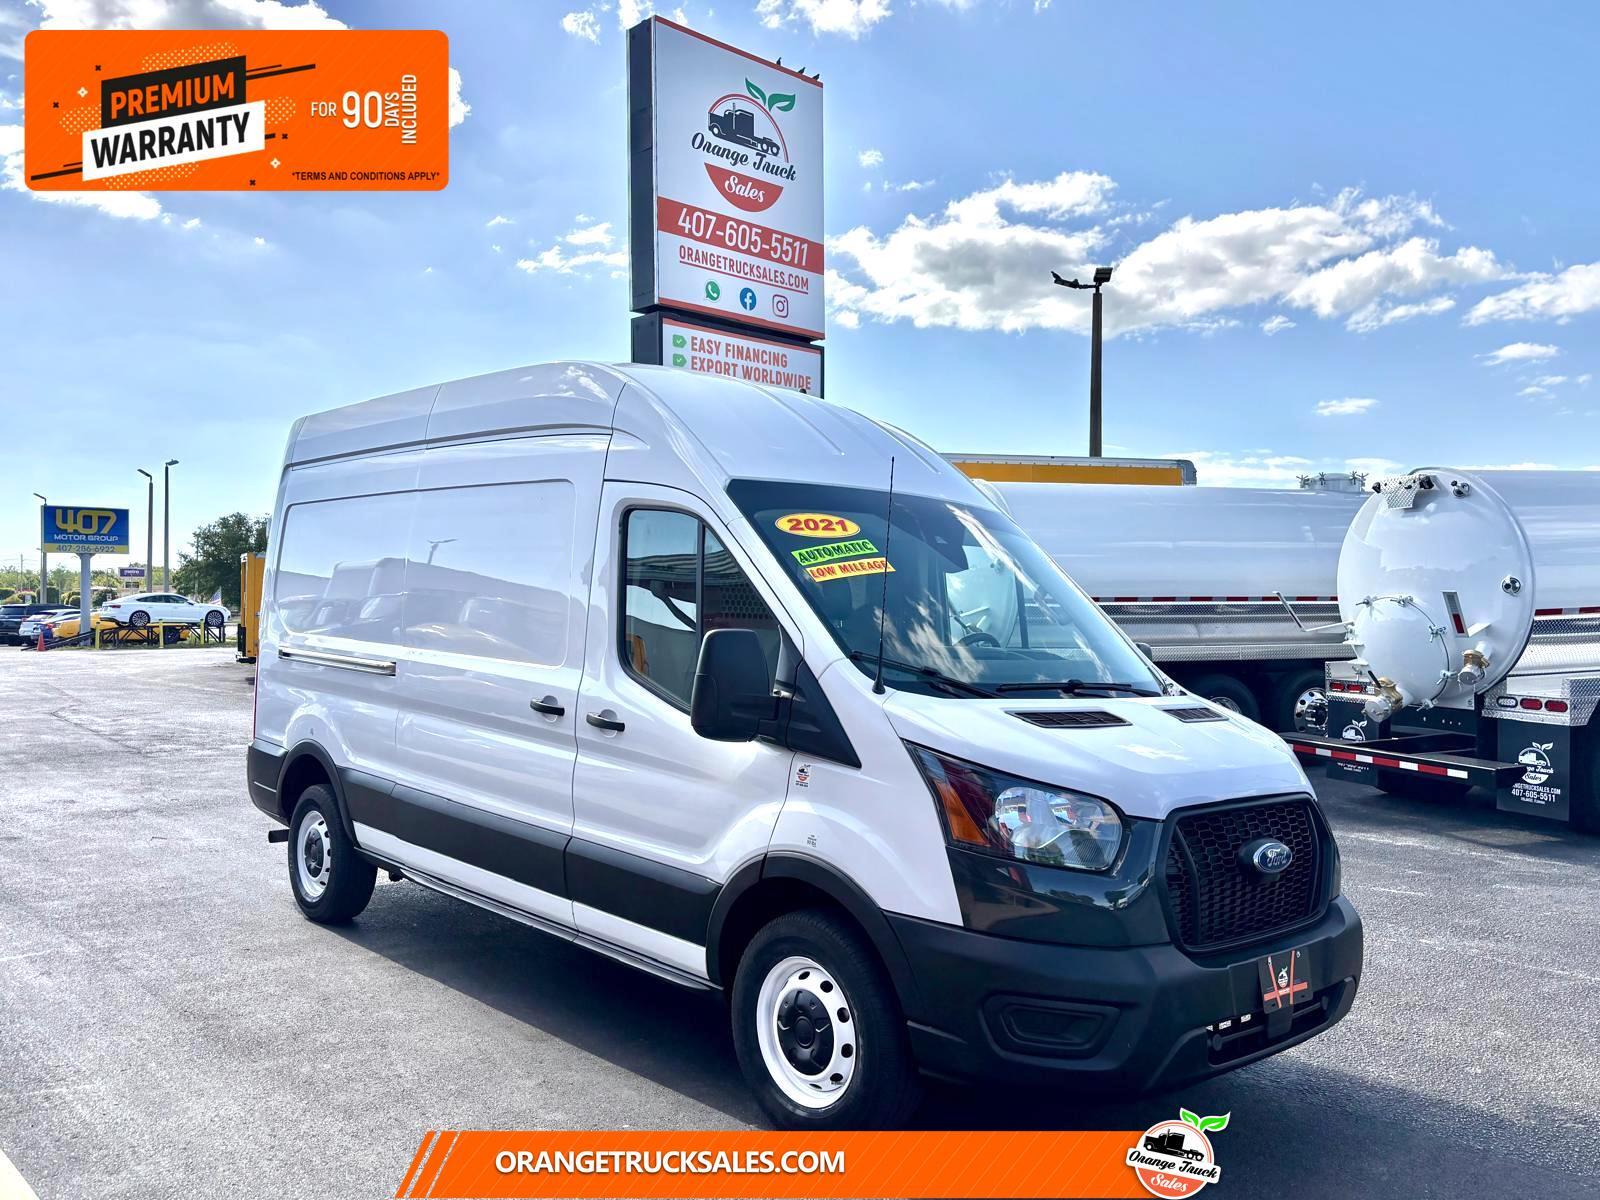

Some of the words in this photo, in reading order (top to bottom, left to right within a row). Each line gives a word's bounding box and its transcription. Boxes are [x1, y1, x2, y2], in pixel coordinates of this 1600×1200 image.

[691, 132, 749, 167] Orange
[752, 152, 797, 182] Truck
[724, 175, 766, 203] Sales
[677, 207, 809, 267] 407-605-5511
[679, 245, 809, 291] ORANGETRUCKSALES.COM
[690, 335, 721, 356] EASY
[725, 343, 788, 368] FINANCING
[690, 356, 739, 378] EXPORT
[741, 365, 812, 390] WORLDWIDE
[55, 508, 117, 534] 407
[787, 518, 849, 532] 2021
[87, 534, 119, 542] GROUP
[799, 540, 874, 563] AUTOMATIC
[809, 565, 837, 578] LOW
[838, 559, 888, 576] MILEAGE
